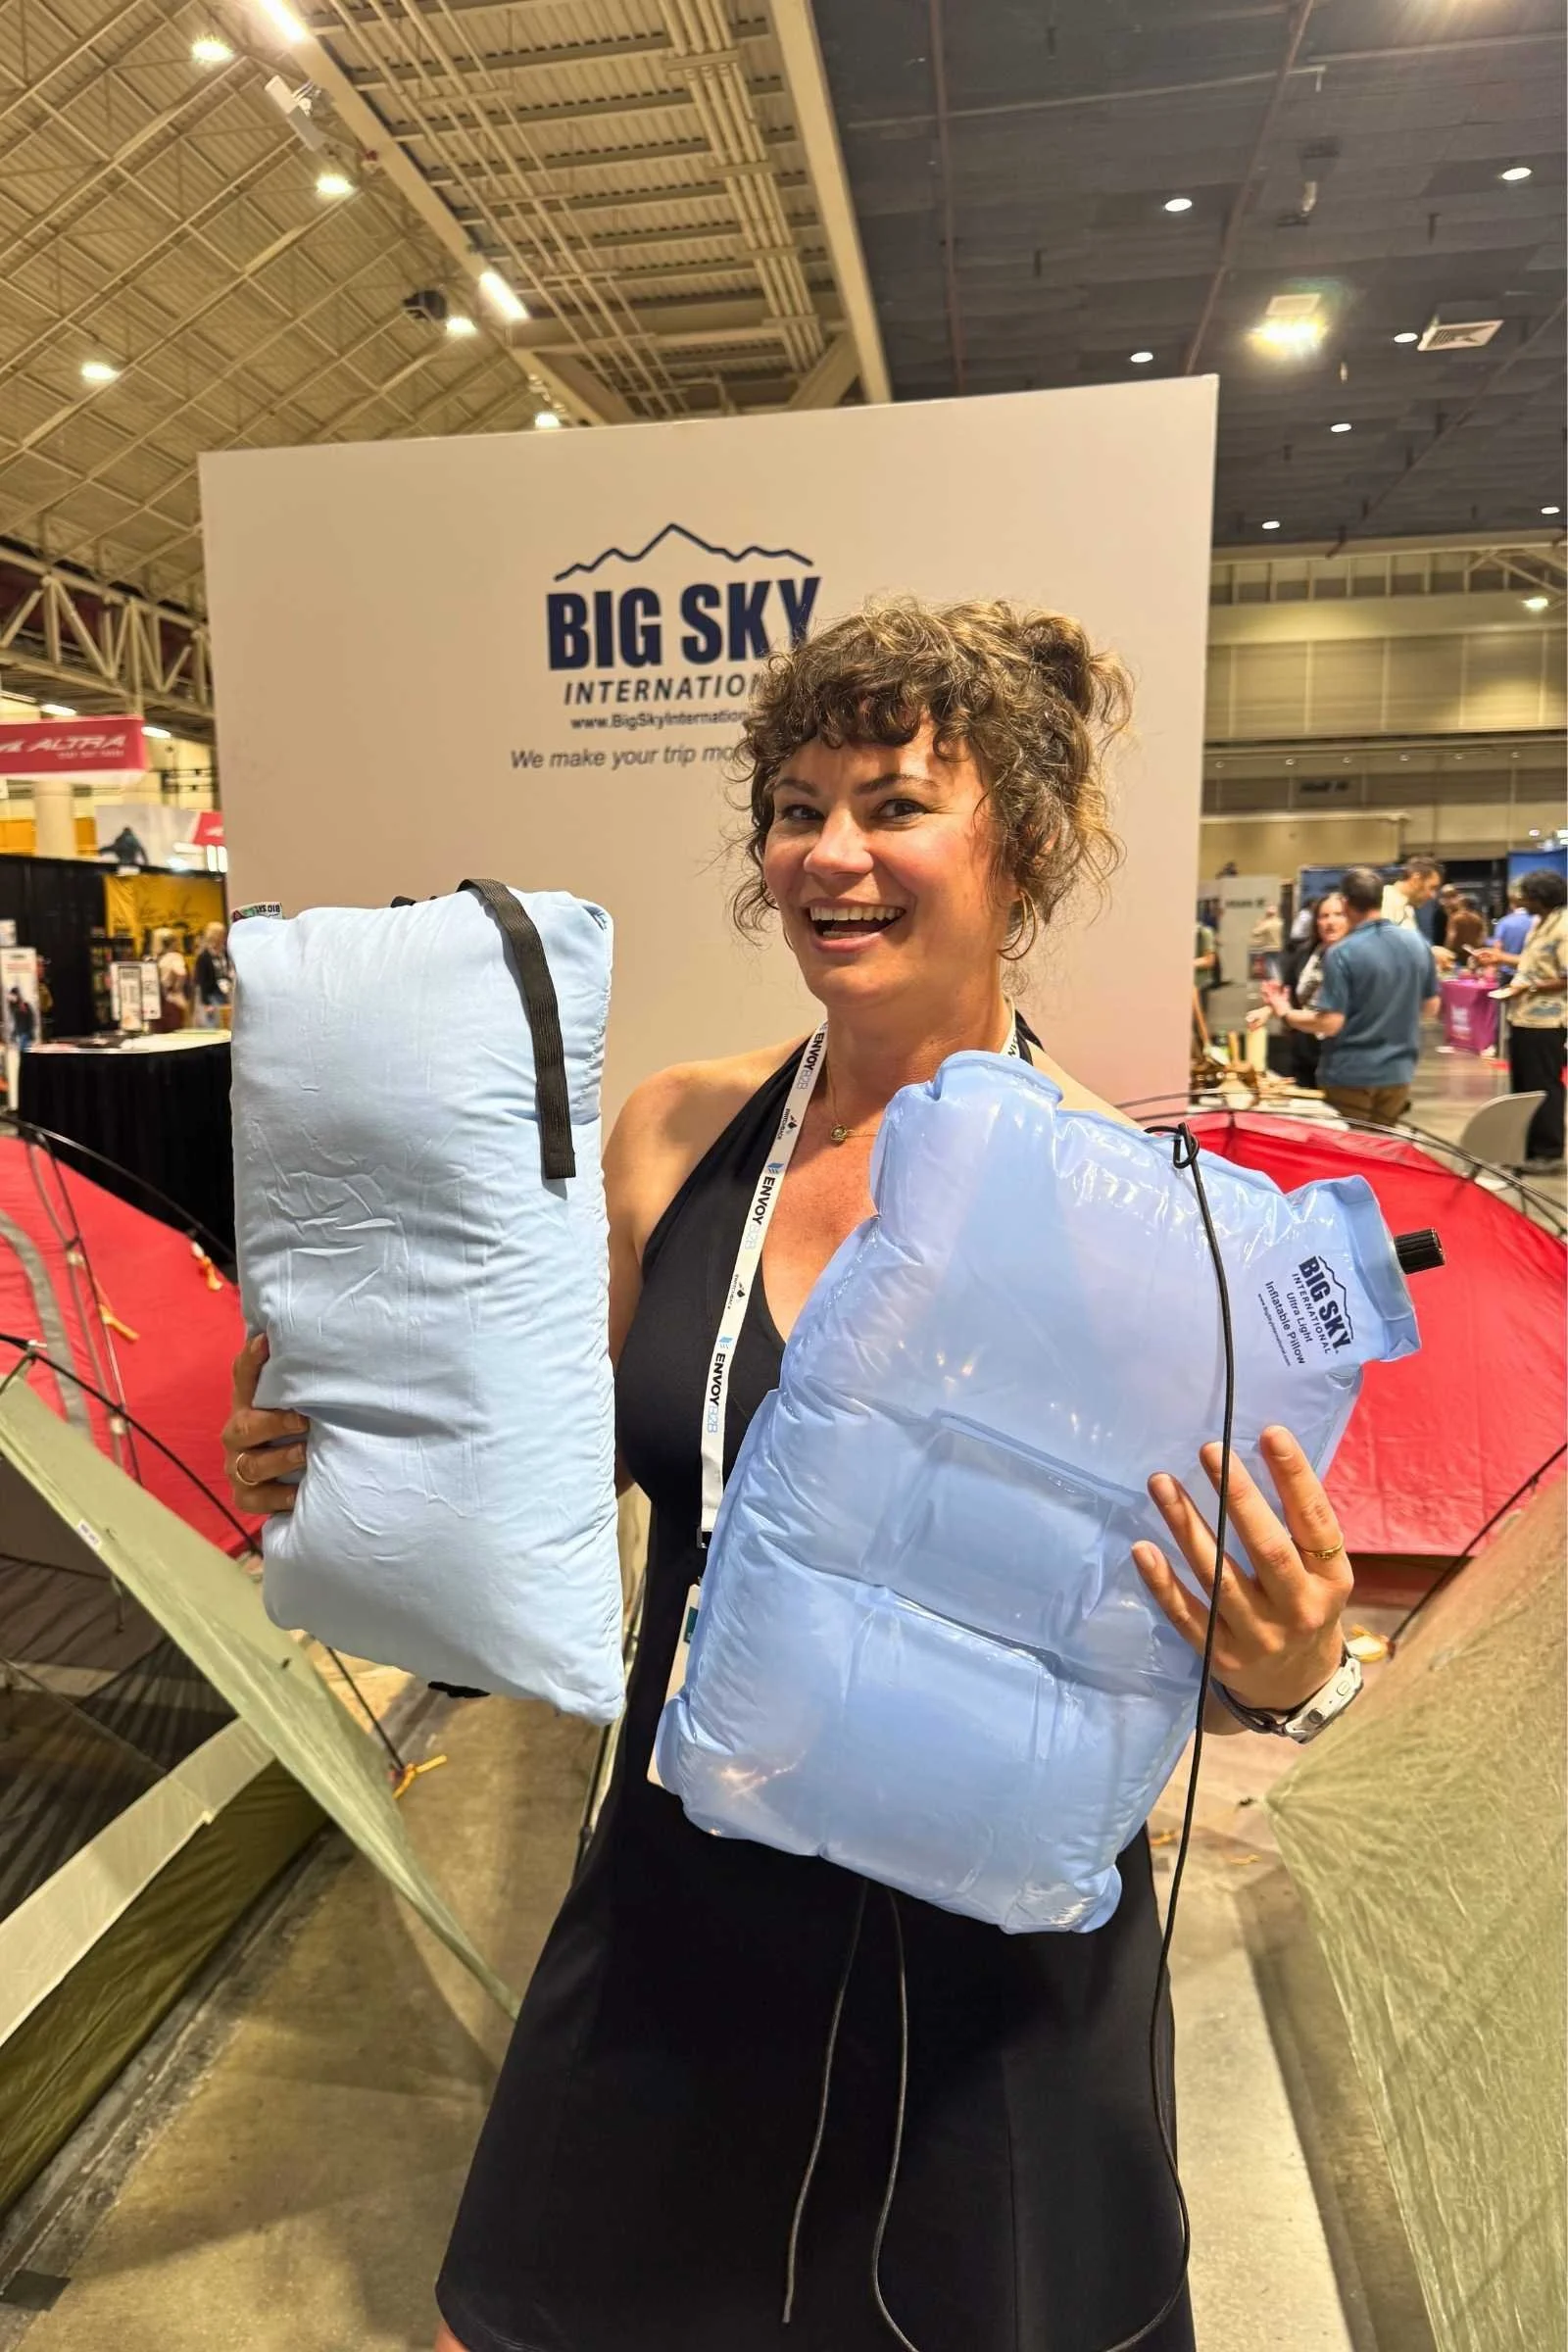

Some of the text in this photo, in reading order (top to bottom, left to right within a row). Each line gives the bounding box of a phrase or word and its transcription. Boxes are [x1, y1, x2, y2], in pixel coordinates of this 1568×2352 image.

[547, 576, 821, 671] BIG SKY
[26, 734, 126, 753] ALTRA
[510, 750, 544, 770] We
[549, 748, 605, 768] make
[612, 748, 659, 771] your
[662, 743, 697, 766] trip
[1265, 1281, 1305, 1364] Inflatable Pillow
[1286, 1292, 1313, 1343] Ultra Light
[1292, 1273, 1331, 1354] INTERNATIONAL
[1298, 1255, 1351, 1349] BIG SKY
